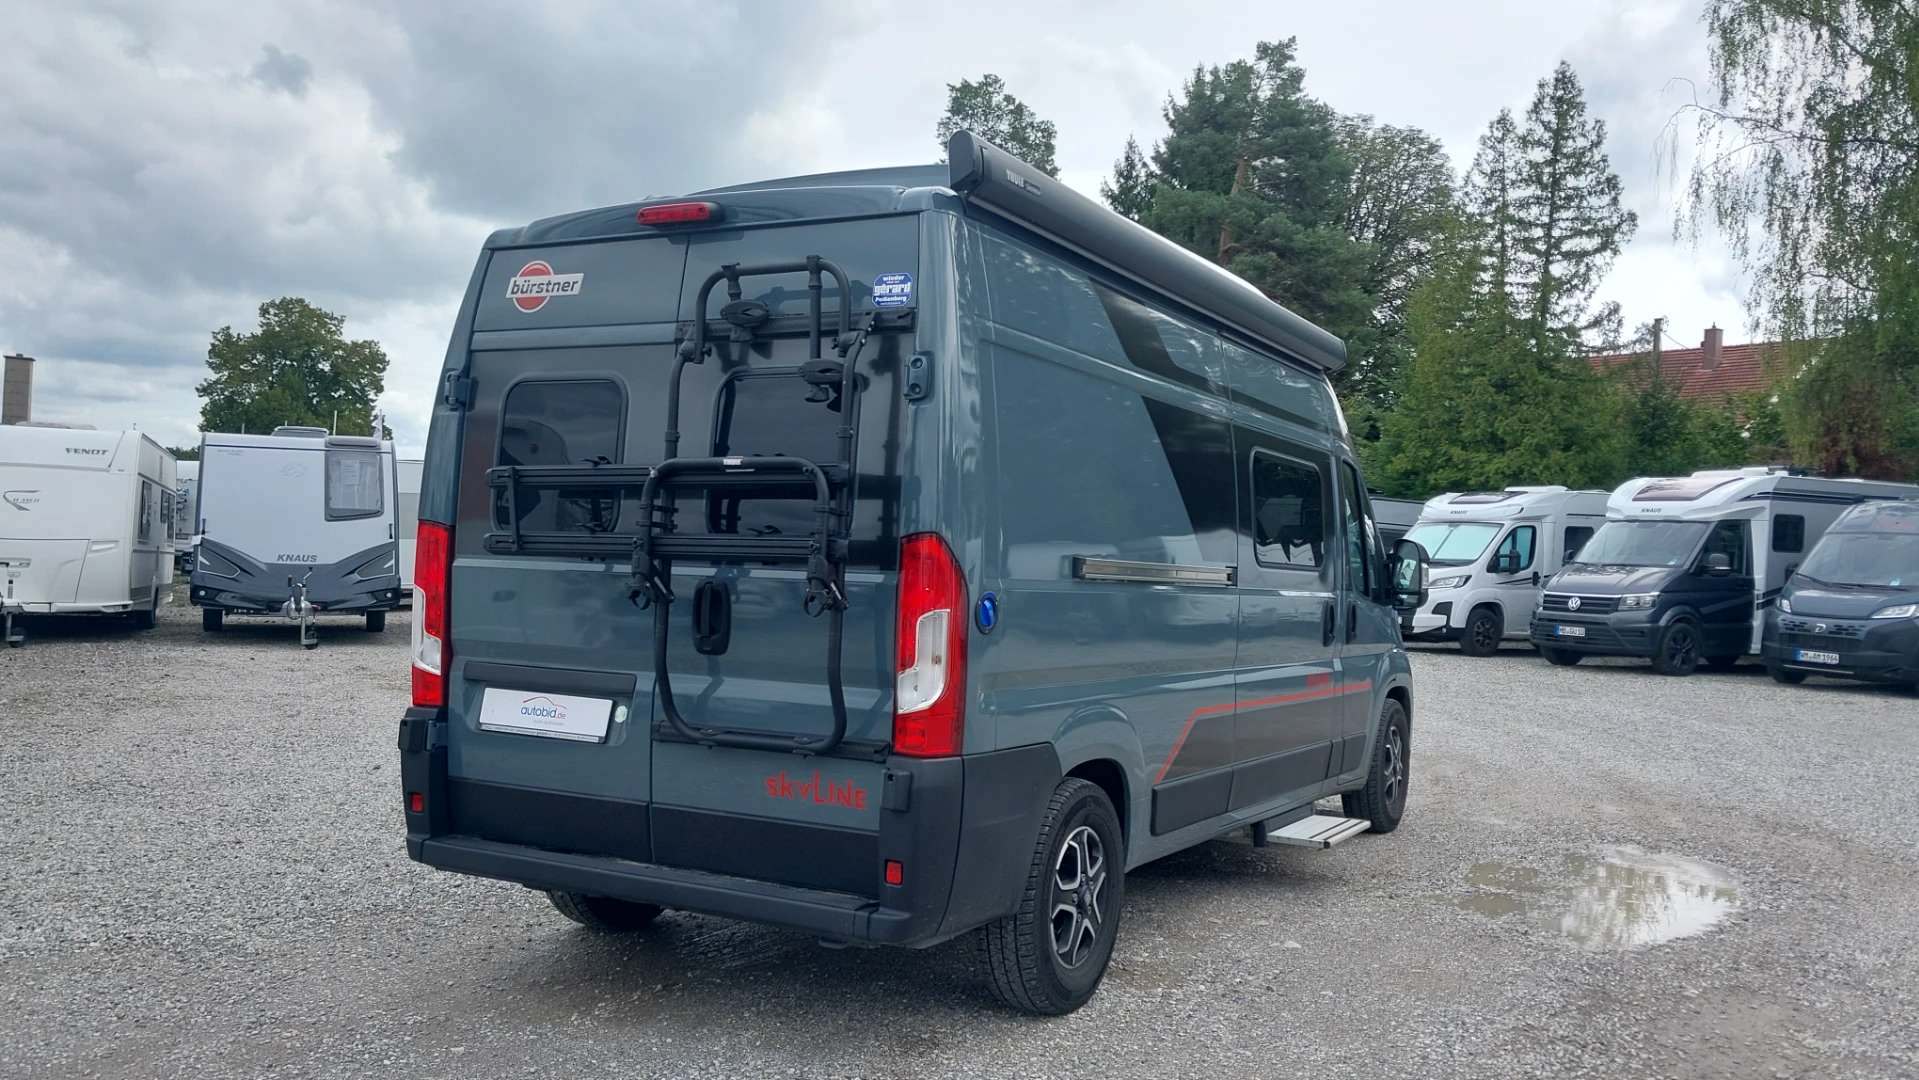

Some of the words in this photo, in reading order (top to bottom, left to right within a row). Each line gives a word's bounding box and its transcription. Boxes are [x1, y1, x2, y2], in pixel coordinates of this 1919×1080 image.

[510, 279, 579, 295] bürstner
[65, 447, 109, 456] FENDT
[276, 553, 318, 563] KNAUS
[520, 704, 567, 721] autobid.de
